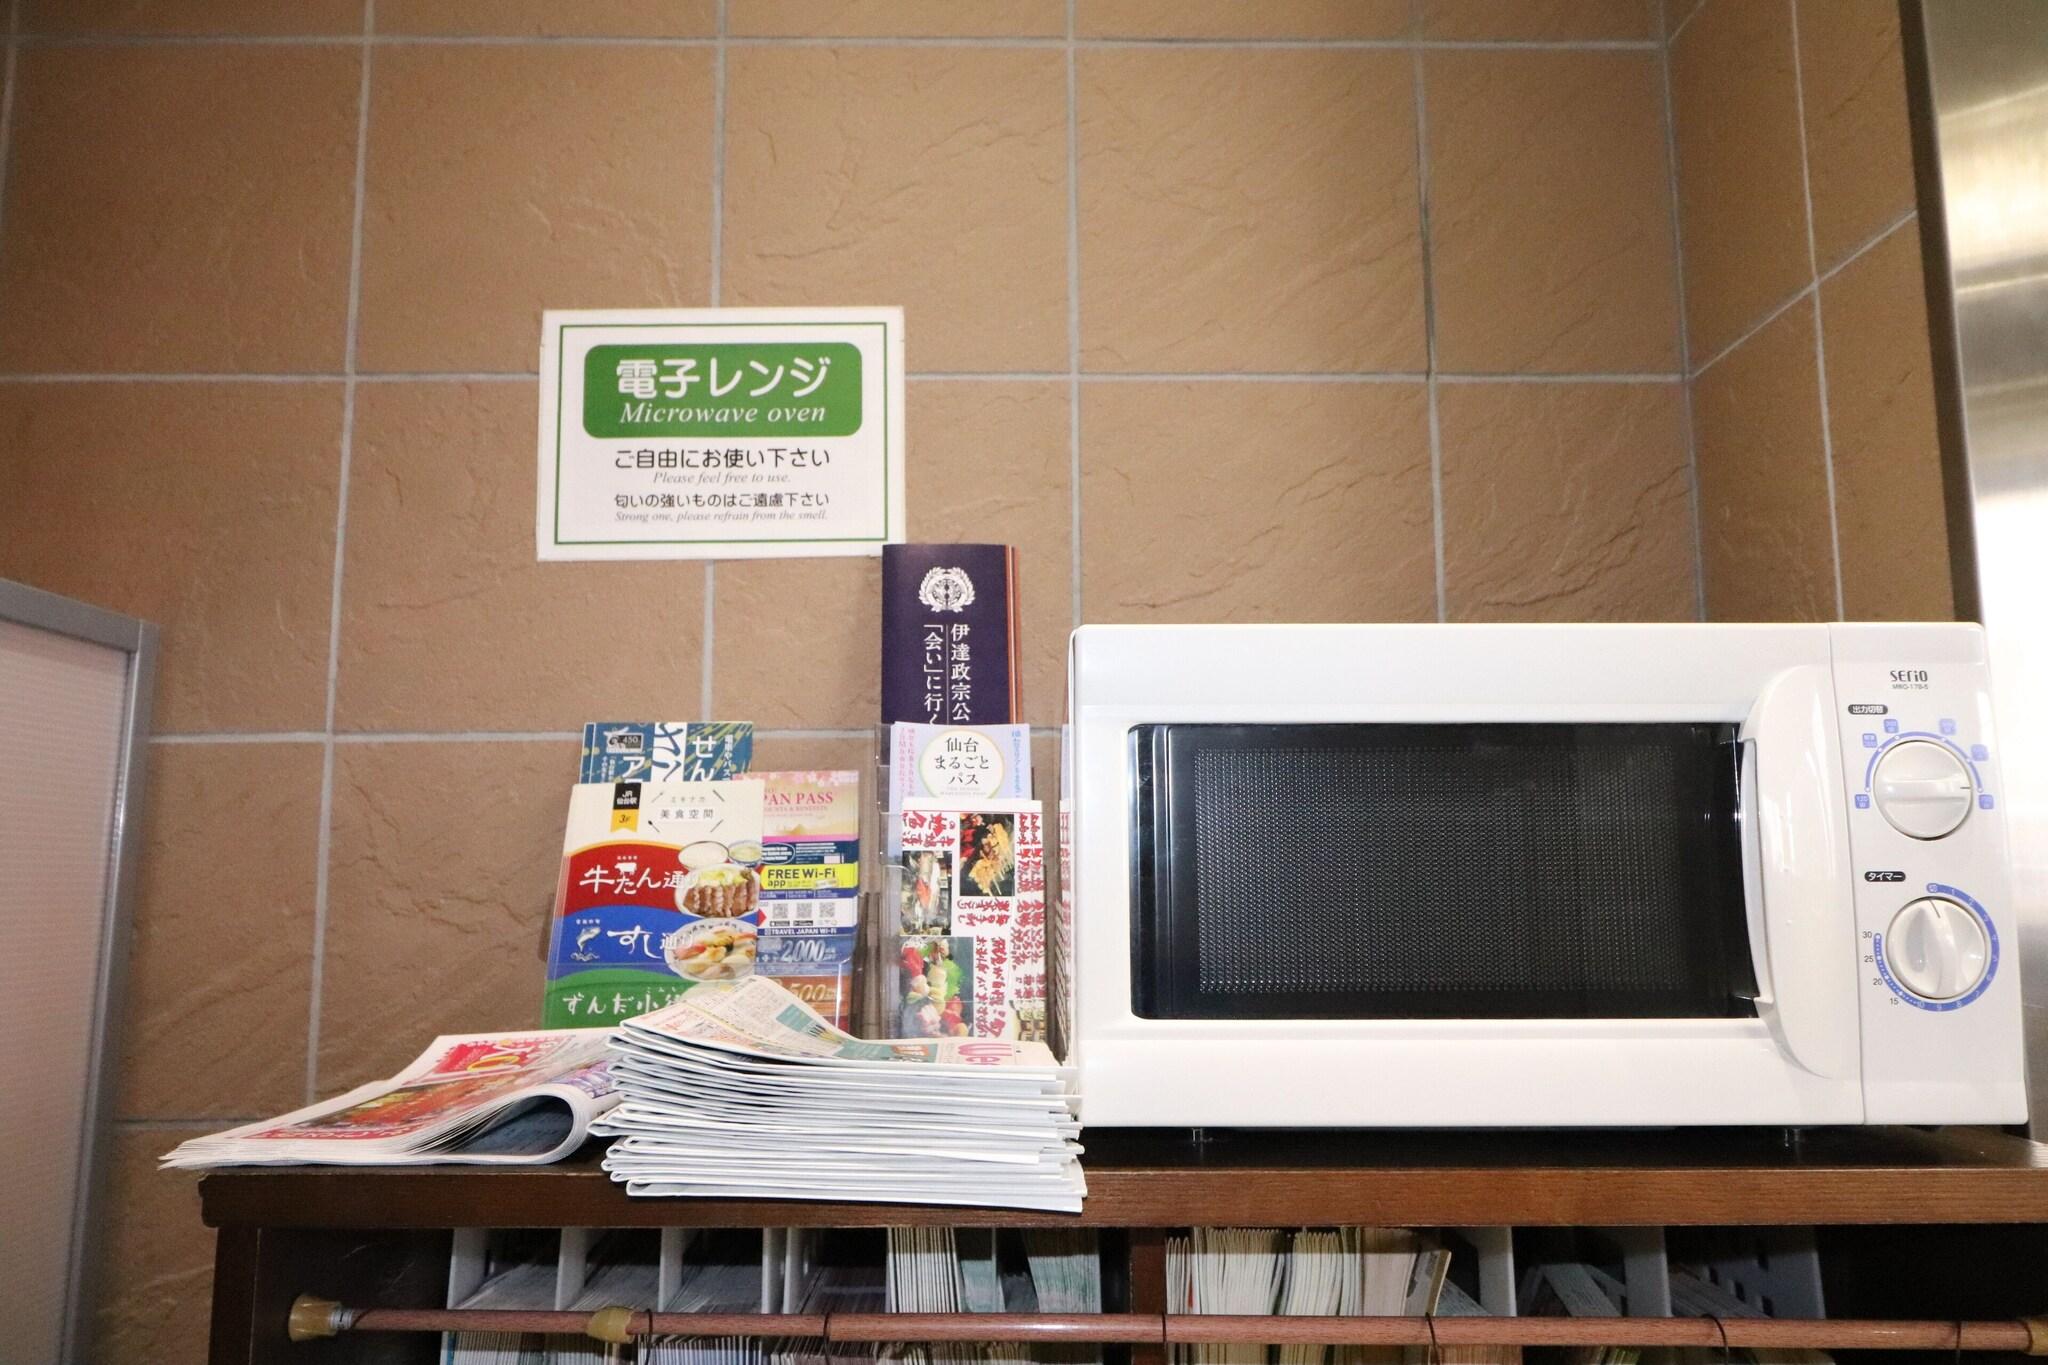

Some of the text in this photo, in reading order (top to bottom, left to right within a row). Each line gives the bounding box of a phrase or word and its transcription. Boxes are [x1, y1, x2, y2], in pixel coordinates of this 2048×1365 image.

[616, 357, 832, 400] 電子レンジ
[620, 402, 826, 424] Microwave oven
[614, 448, 831, 470] ご自由にお使い下さい
[653, 472, 792, 485] Please feel free to use.
[614, 492, 830, 509] 匂いの強いものはご遠慮下さい
[614, 511, 649, 523] Strong
[676, 511, 711, 523] please
[713, 510, 749, 522] refrain
[751, 510, 777, 522] from
[779, 511, 795, 521] the
[951, 623, 972, 721] 伊達政宗公
[946, 737, 979, 753] 仙台
[934, 756, 990, 770] まるごと
[948, 772, 980, 786] パス
[797, 792, 833, 805] PASS
[660, 808, 714, 820] 美食空間
[768, 868, 836, 879] FREE Wi-Fi
[1867, 872, 1902, 881] タイマー
[768, 880, 786, 889] app
[771, 928, 795, 936] TRAVEL
[1862, 931, 1873, 939] 30
[1864, 955, 1874, 963] 25
[1873, 978, 1883, 986] 20
